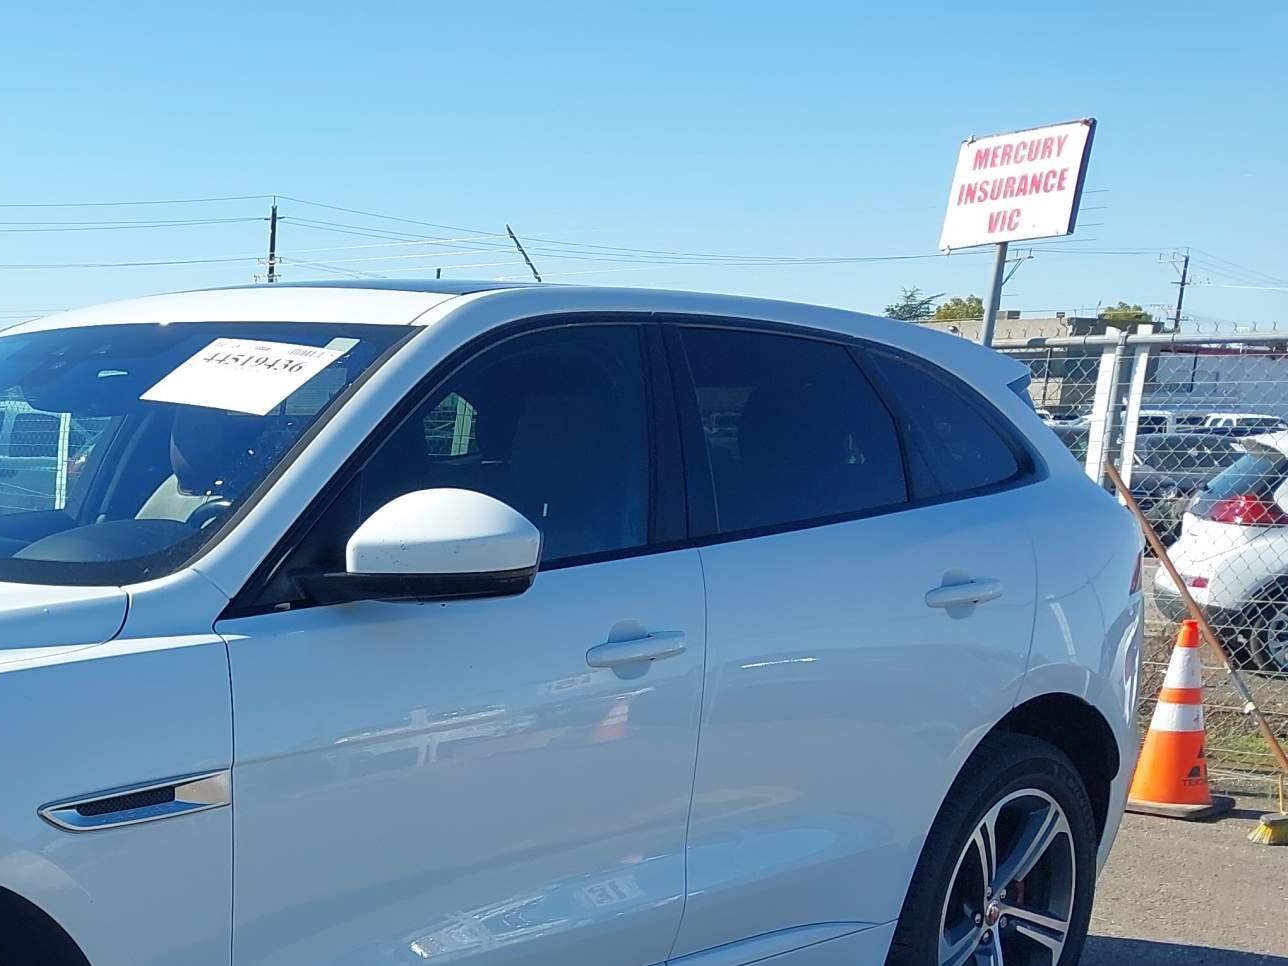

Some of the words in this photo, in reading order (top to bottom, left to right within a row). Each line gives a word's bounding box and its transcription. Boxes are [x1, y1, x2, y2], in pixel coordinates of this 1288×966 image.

[972, 134, 1069, 171] MERCURY
[957, 167, 1069, 206] INSURANCE
[988, 208, 1021, 234] VIC
[204, 352, 306, 373] 44519436
